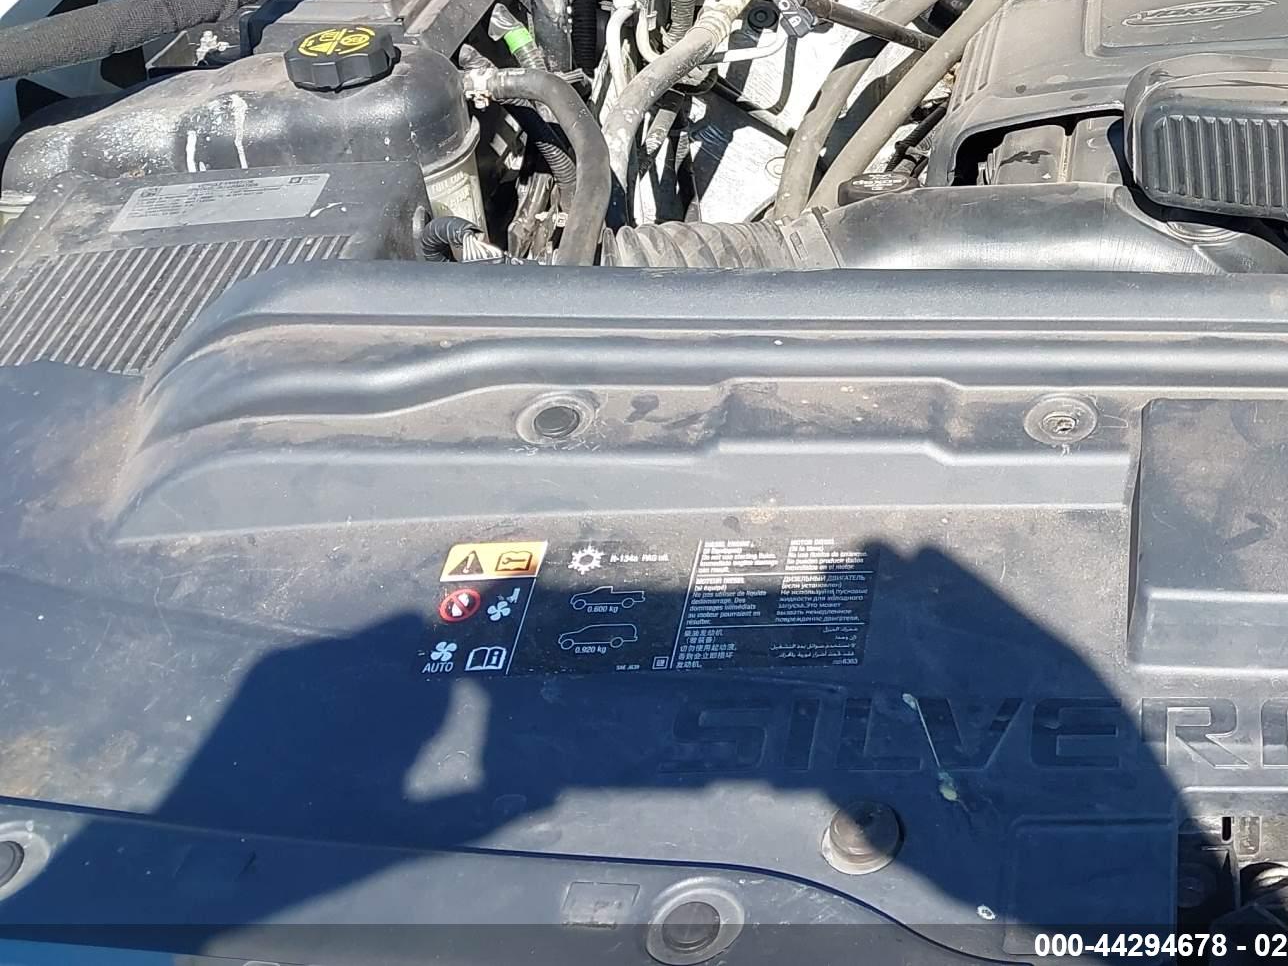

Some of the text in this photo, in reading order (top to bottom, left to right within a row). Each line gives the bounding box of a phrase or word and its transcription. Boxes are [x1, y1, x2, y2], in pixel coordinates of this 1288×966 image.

[610, 554, 639, 563] R-134a
[575, 646, 607, 654] 0.920 kg
[421, 661, 454, 674] AUTO
